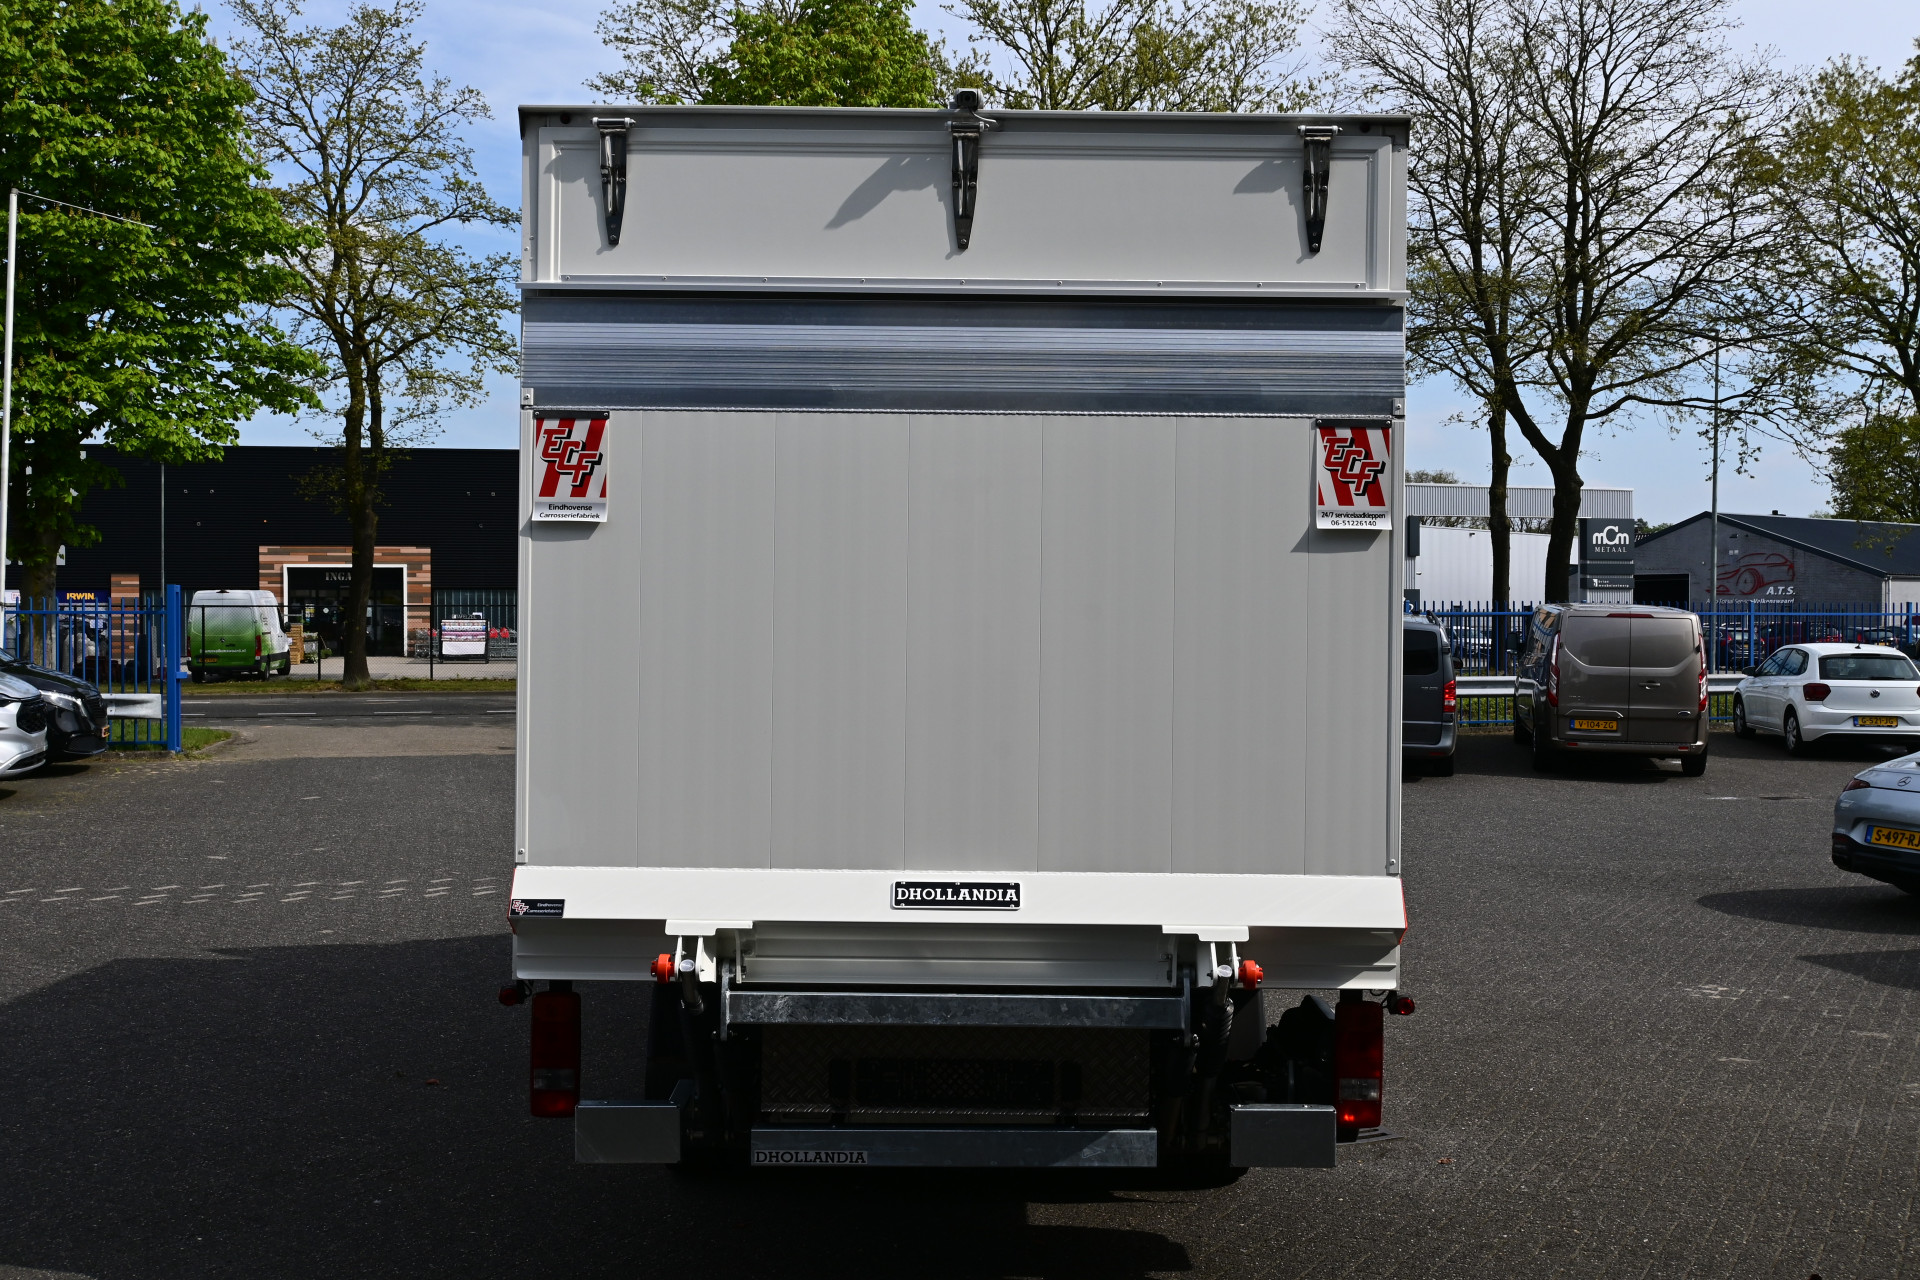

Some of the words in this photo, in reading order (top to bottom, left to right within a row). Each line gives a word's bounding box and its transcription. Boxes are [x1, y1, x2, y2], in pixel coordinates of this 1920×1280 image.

[541, 428, 602, 486] ECF
[1323, 436, 1386, 496] ECF
[325, 572, 352, 581] INGA
[66, 592, 95, 600] IRWIN
[1766, 586, 1796, 595] A.T.S.
[1578, 720, 1614, 729] V-104-ZG
[1875, 829, 1920, 847] S-497-RJ
[896, 888, 1018, 901] DHOLLANDIA
[755, 1151, 867, 1164] DHOLLANDIA
